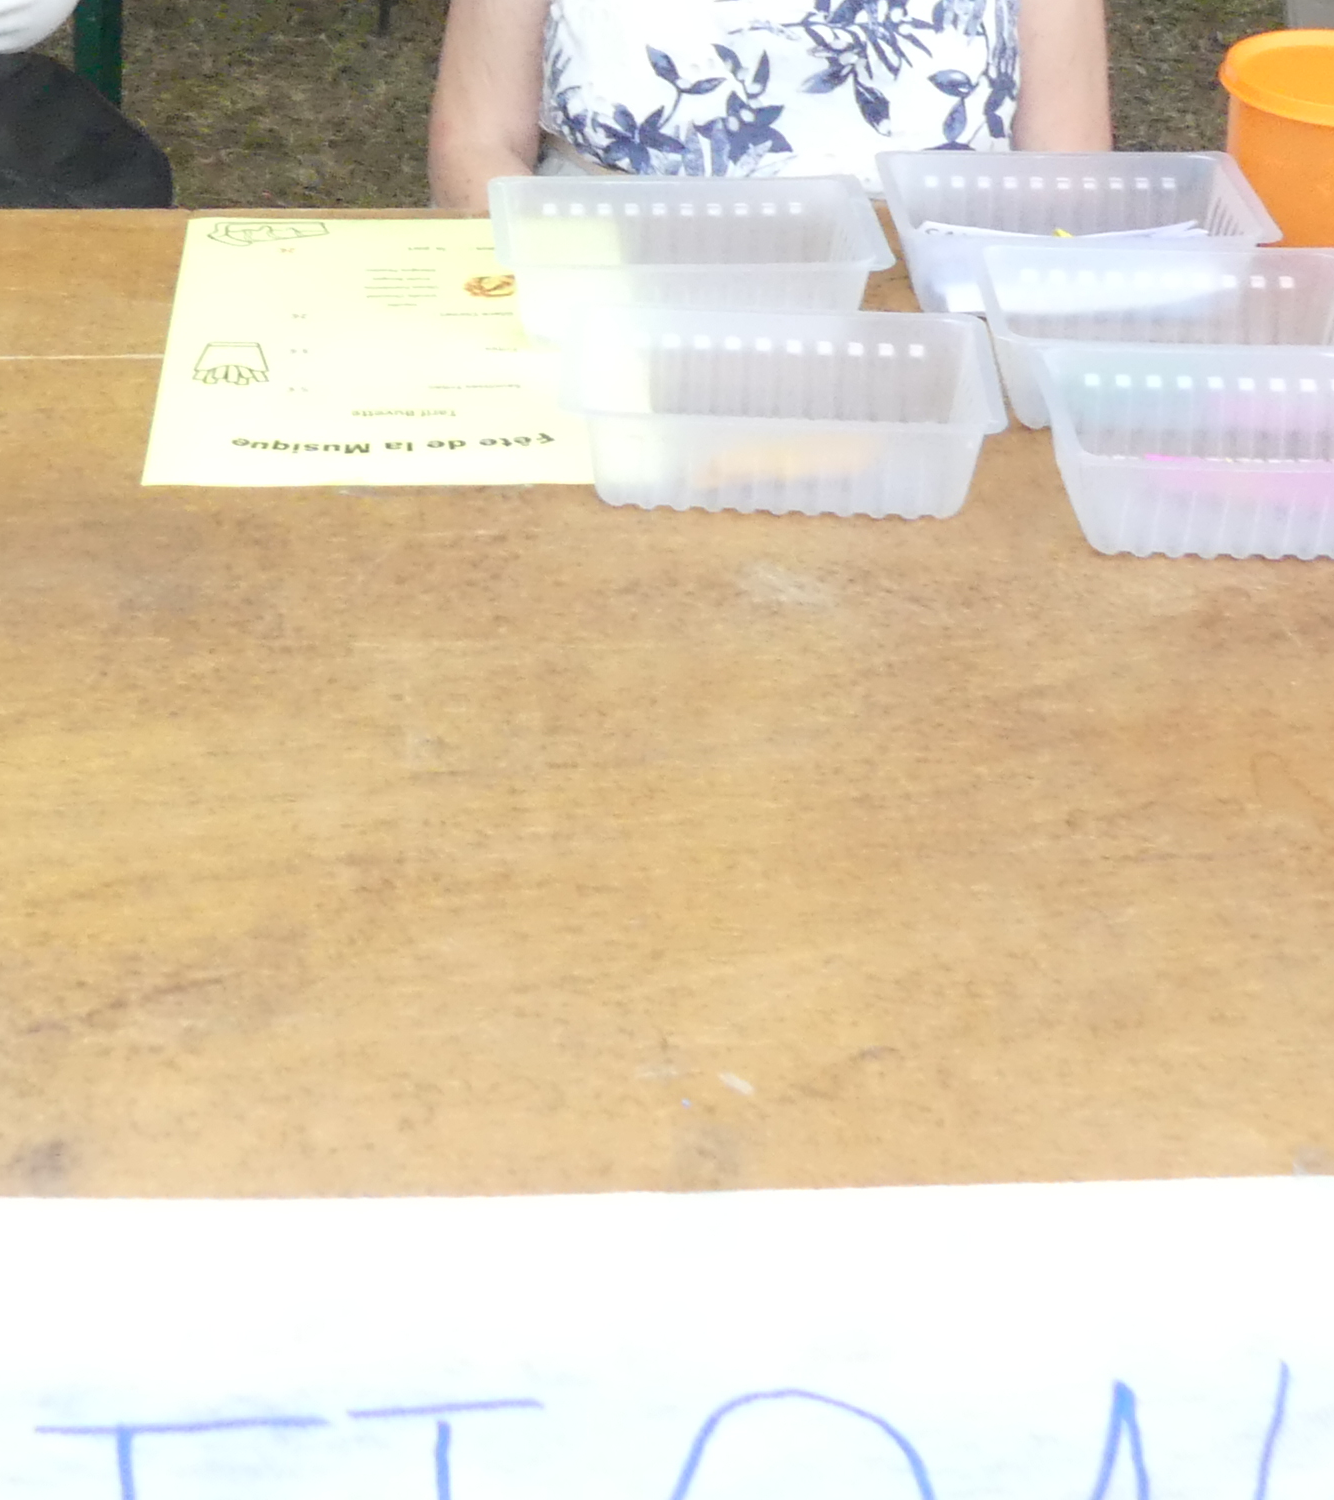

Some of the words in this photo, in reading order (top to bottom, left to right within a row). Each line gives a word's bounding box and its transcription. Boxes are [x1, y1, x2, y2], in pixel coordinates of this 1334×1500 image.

[232, 437, 370, 454] Musique
[427, 439, 466, 450] de
[479, 432, 555, 447] Fête
[385, 441, 413, 452] la
